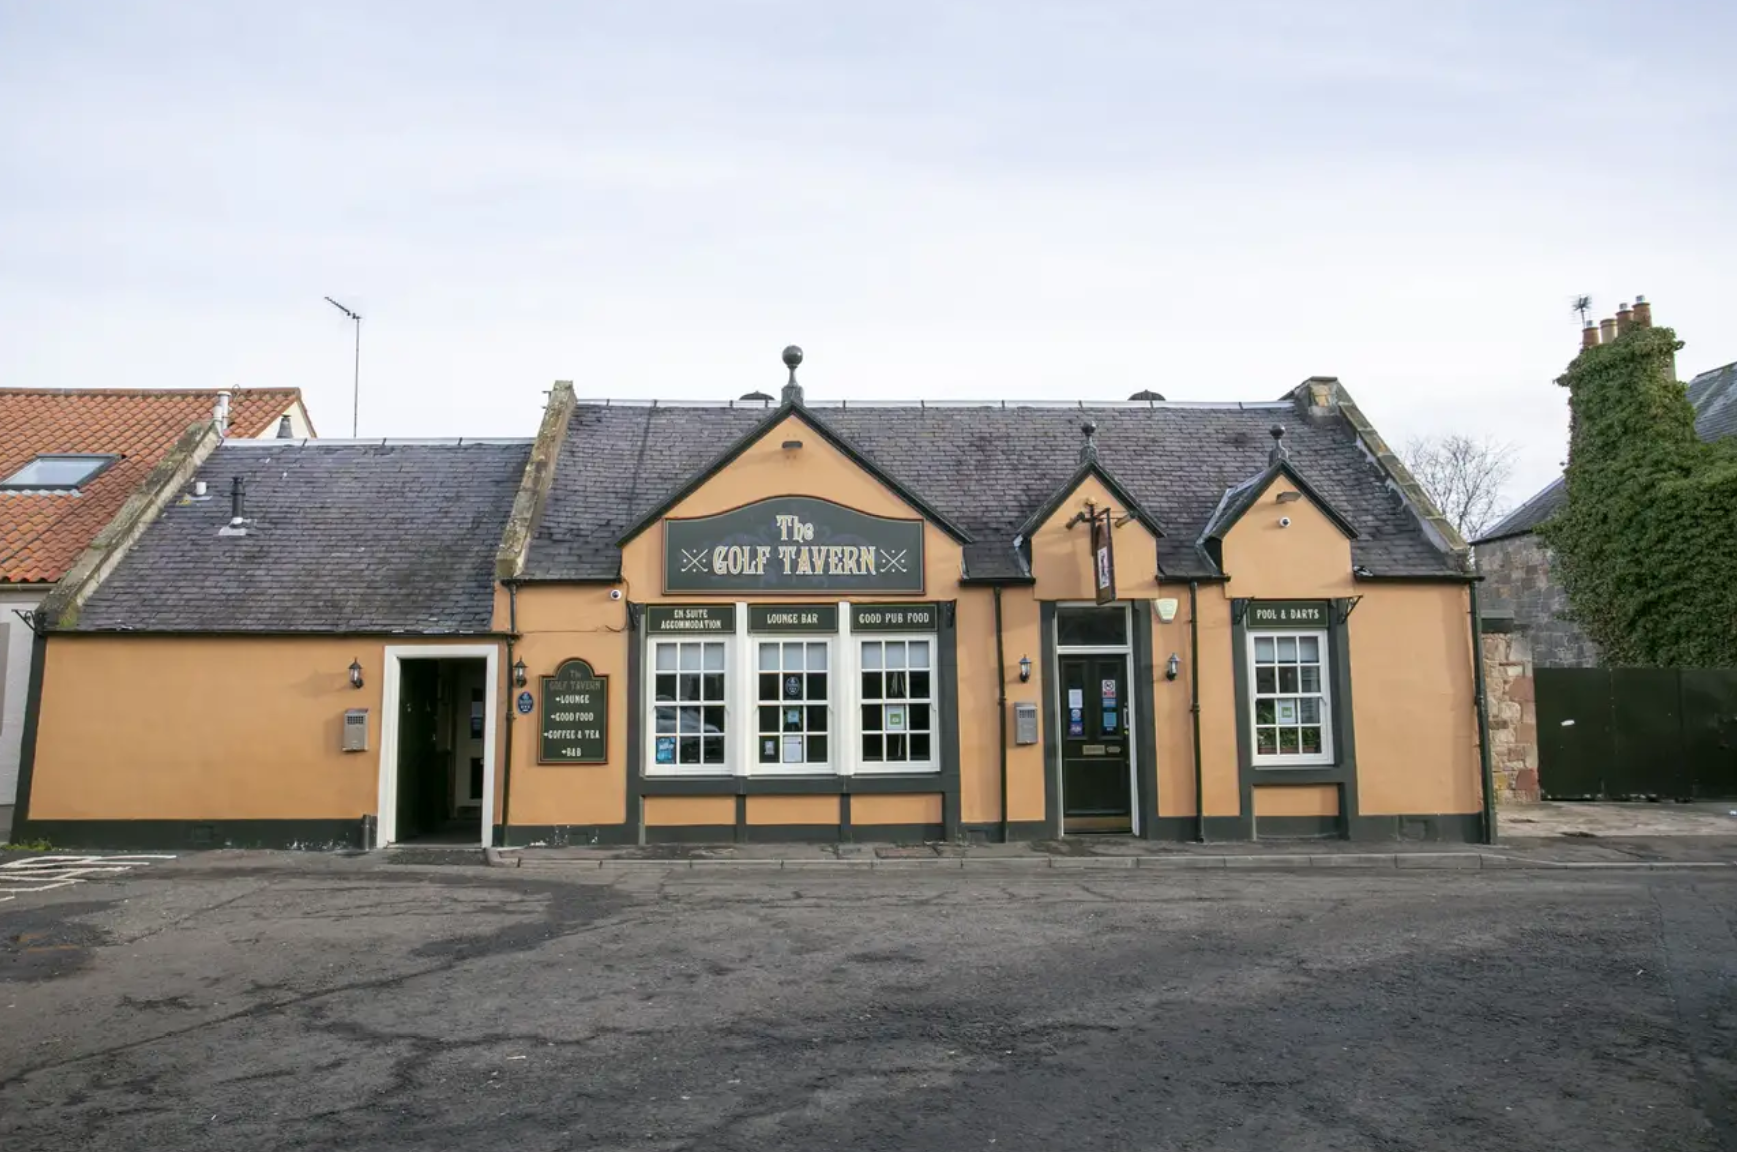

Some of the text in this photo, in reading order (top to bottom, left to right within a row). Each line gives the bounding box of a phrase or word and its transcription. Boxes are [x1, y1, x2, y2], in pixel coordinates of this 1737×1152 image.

[776, 515, 814, 542] The
[712, 546, 877, 576] GOLF TAVERN
[767, 613, 818, 624] LOUNGE BAR
[859, 612, 930, 624] GOOD PUB FOOD
[1256, 609, 1319, 619] POOL & DARTS
[661, 620, 722, 629] ACCOMMODATION
[561, 695, 590, 704] LOUNGE
[555, 712, 594, 721] GOOD FOOD
[548, 730, 600, 739] COFFEE & TEA
[566, 748, 581, 756] B&B
